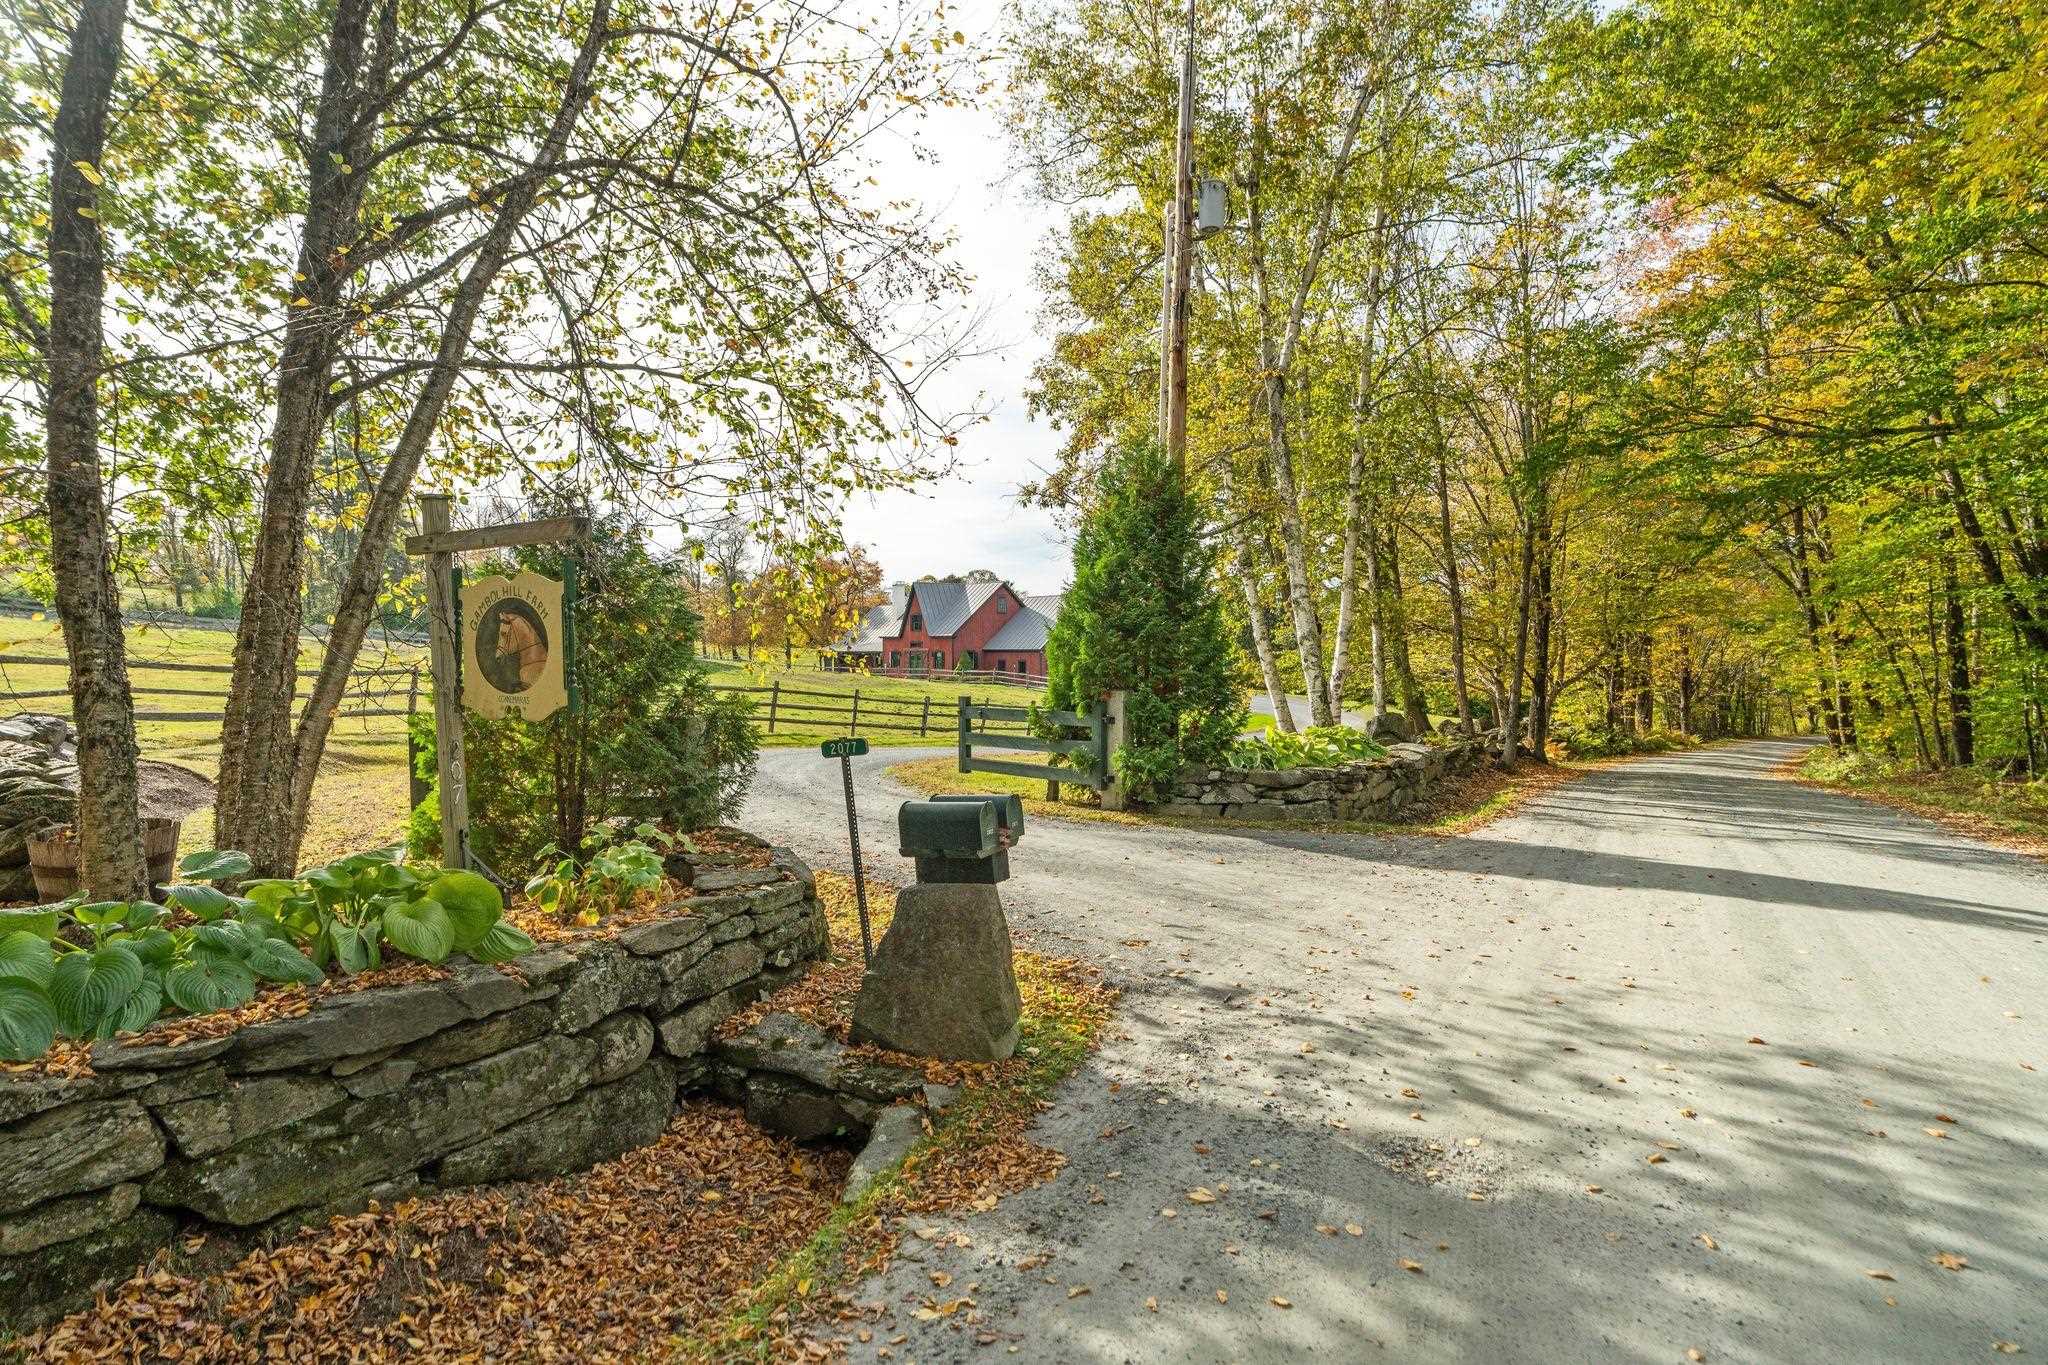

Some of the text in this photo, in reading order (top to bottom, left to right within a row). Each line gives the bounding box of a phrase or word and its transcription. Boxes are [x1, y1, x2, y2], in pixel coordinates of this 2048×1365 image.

[470, 586, 549, 631] GAMBOL HILL FARM
[831, 742, 856, 755] 2077
